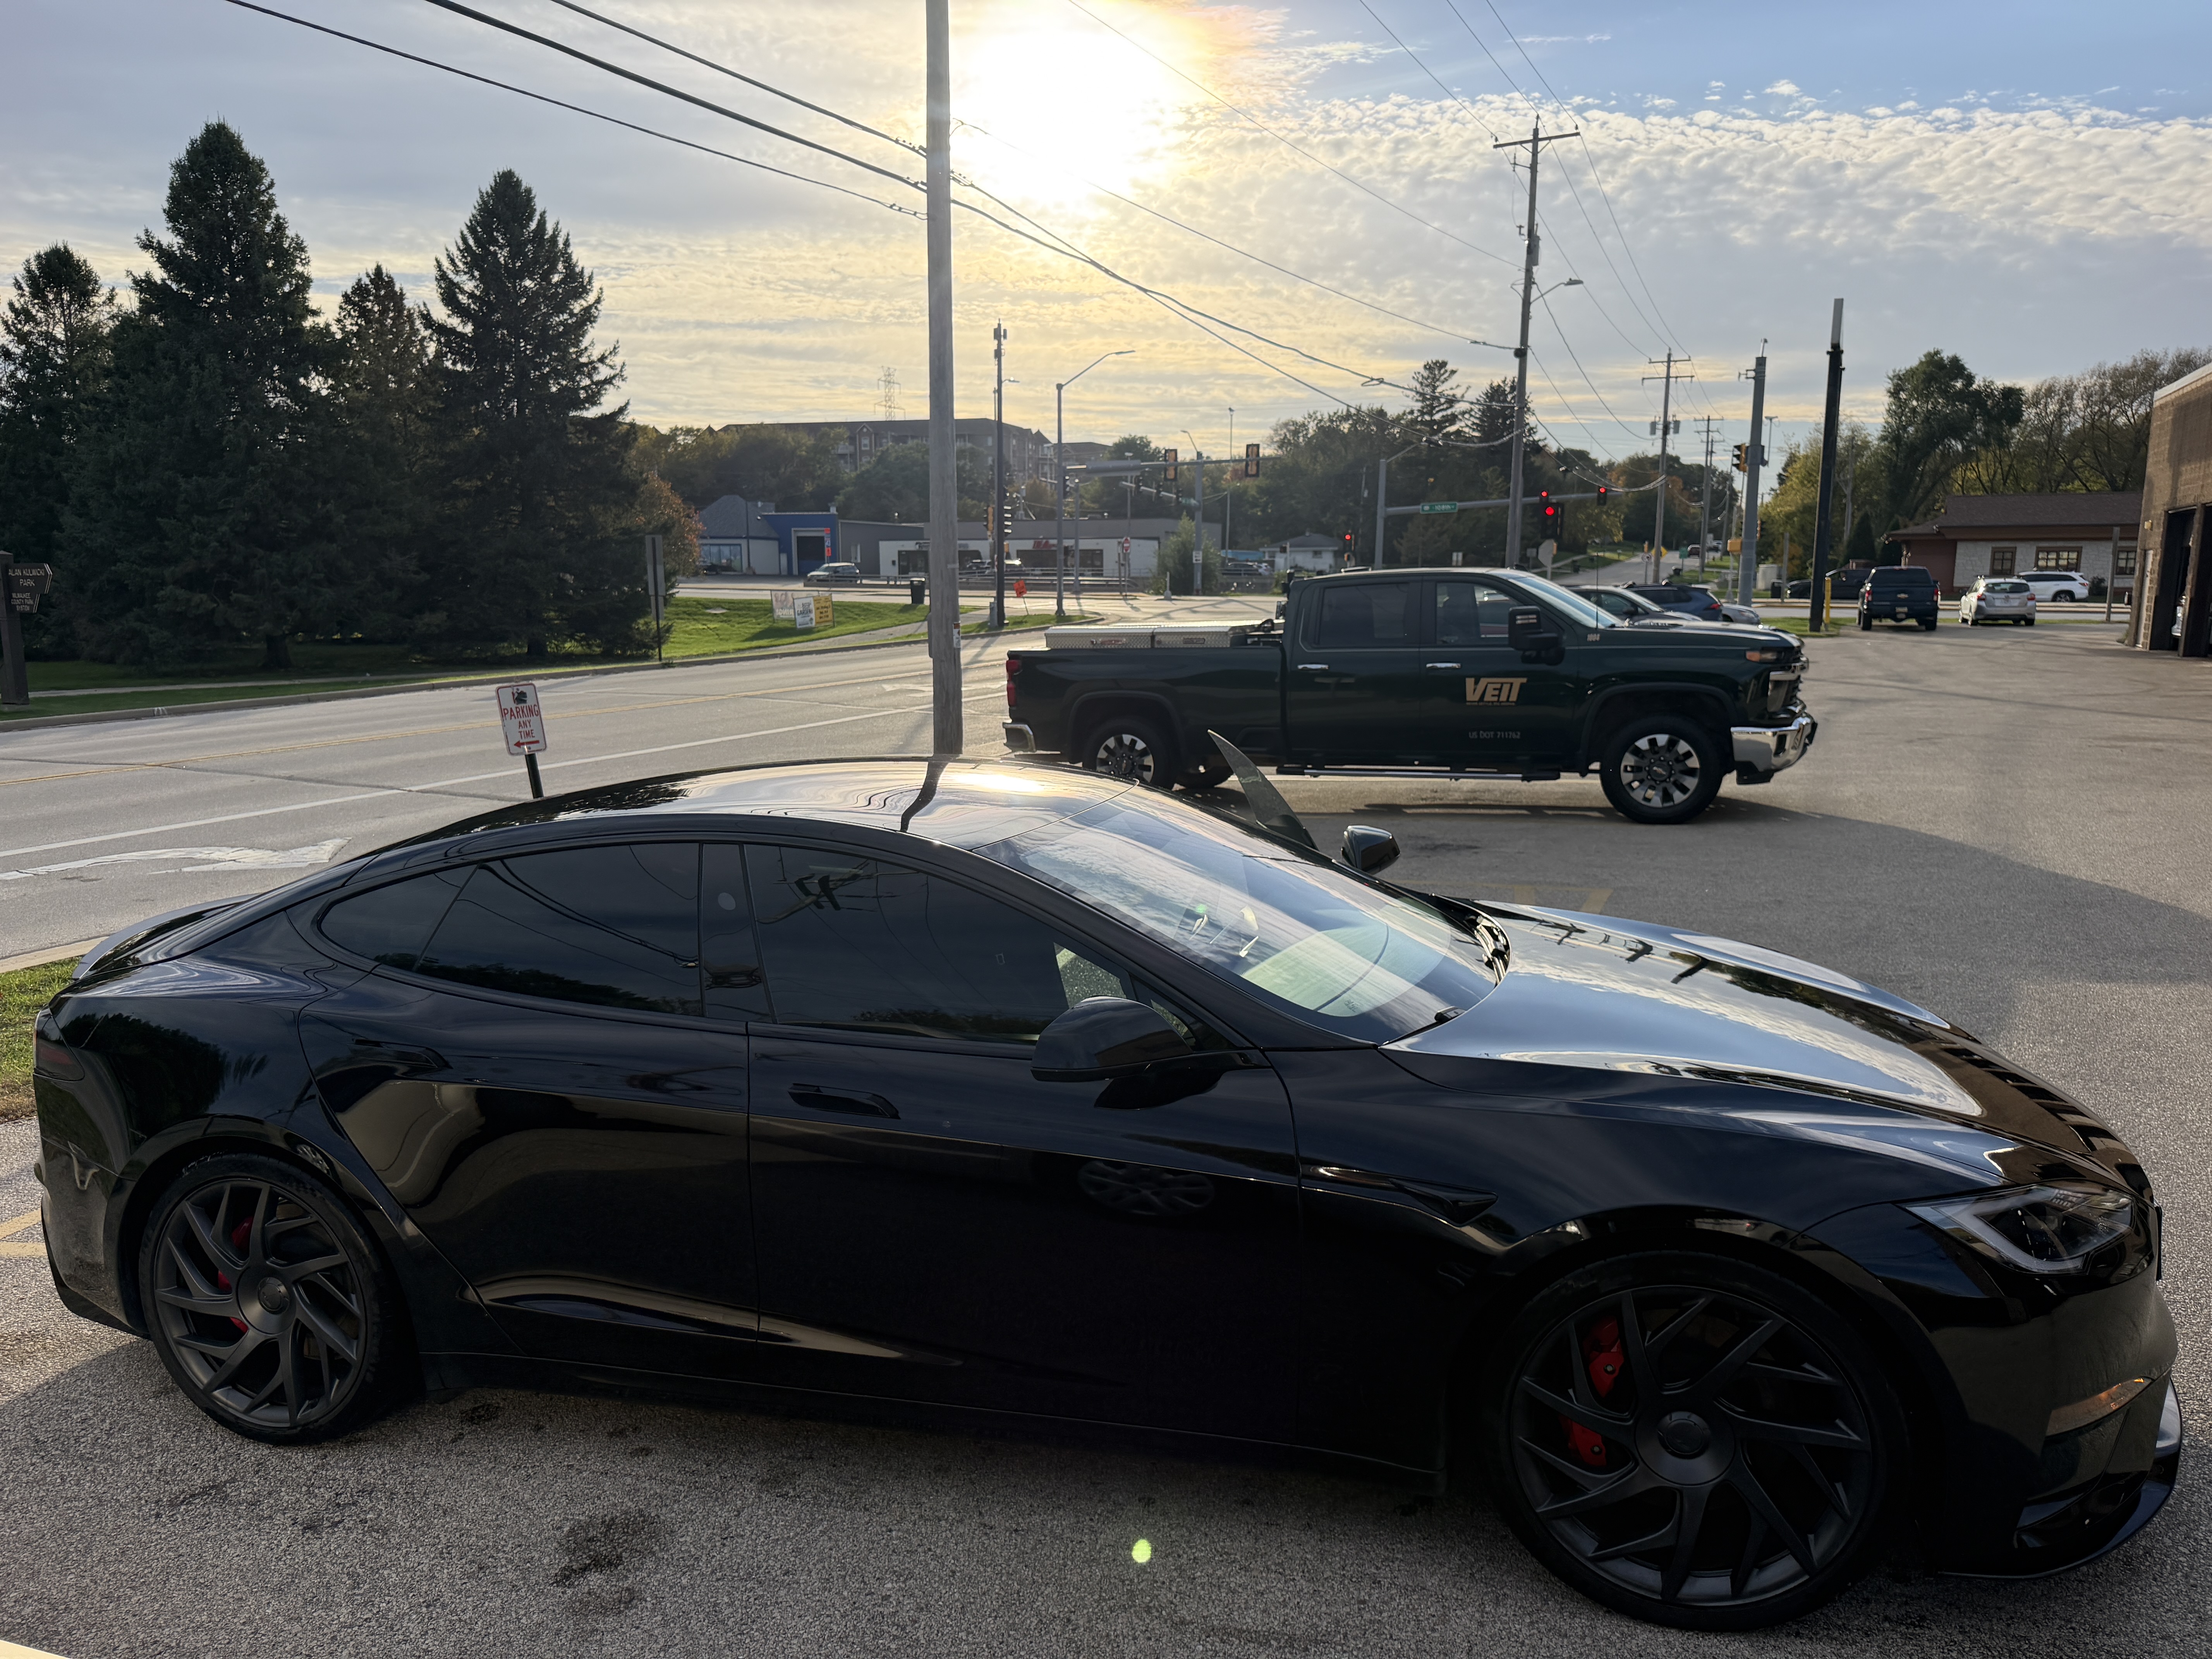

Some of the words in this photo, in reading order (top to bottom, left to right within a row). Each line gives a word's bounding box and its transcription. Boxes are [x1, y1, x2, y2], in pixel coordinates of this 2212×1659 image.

[1465, 678, 1527, 702] VEIT
[503, 704, 539, 720] PARKING
[519, 719, 531, 729] ANY
[519, 729, 535, 739] TIME
